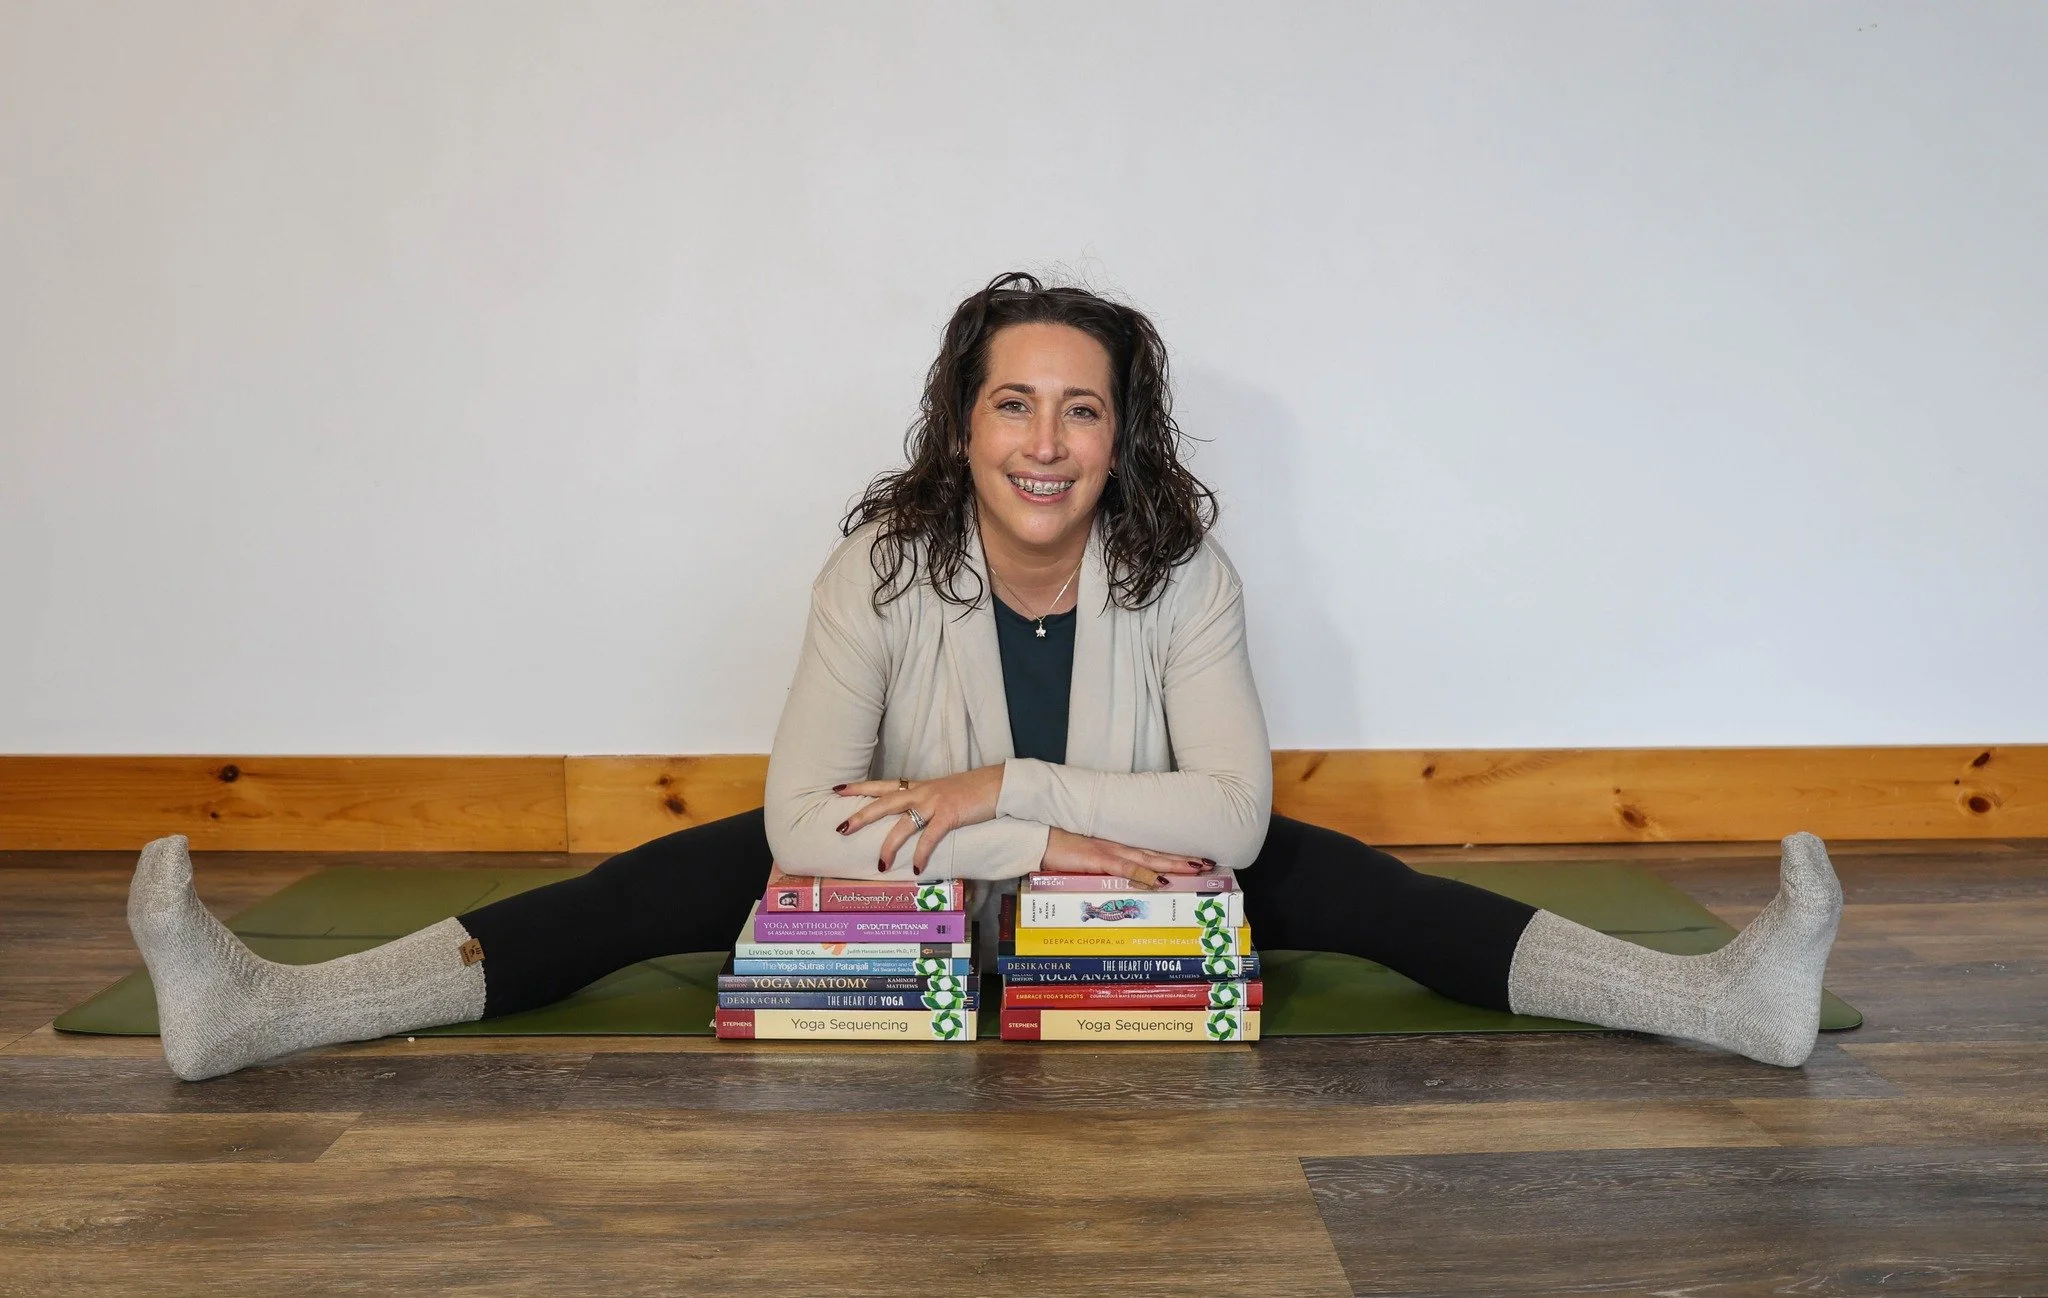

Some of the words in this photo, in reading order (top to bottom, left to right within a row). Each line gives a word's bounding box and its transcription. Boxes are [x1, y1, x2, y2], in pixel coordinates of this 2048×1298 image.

[827, 891, 893, 907] Autobiography
[895, 893, 904, 901] of
[791, 922, 849, 930] MYTHOLOGY
[763, 962, 776, 970] The
[777, 962, 797, 972] Yoga
[798, 962, 825, 970] Sutras
[825, 962, 834, 970] of
[835, 962, 869, 972] Patanjali
[1007, 962, 1072, 970] DESIKACHAR
[1102, 961, 1115, 971] THE
[1118, 961, 1141, 971] HEART
[1143, 961, 1153, 971] OF
[1155, 960, 1182, 971] YOGA
[751, 978, 793, 989] YOGA
[796, 977, 869, 989] ANATOMY
[1039, 974, 1078, 982] YOGA
[727, 996, 791, 1004] DESIKACHAR
[827, 996, 840, 1006] THE
[843, 996, 867, 1006] HEART
[868, 996, 878, 1006] OF
[880, 996, 904, 1006] YOGA
[790, 1018, 825, 1031] Yoga
[829, 1018, 908, 1032] Sequencing
[1076, 1019, 1111, 1032] Yoga
[1115, 1019, 1194, 1033] Sequencing
